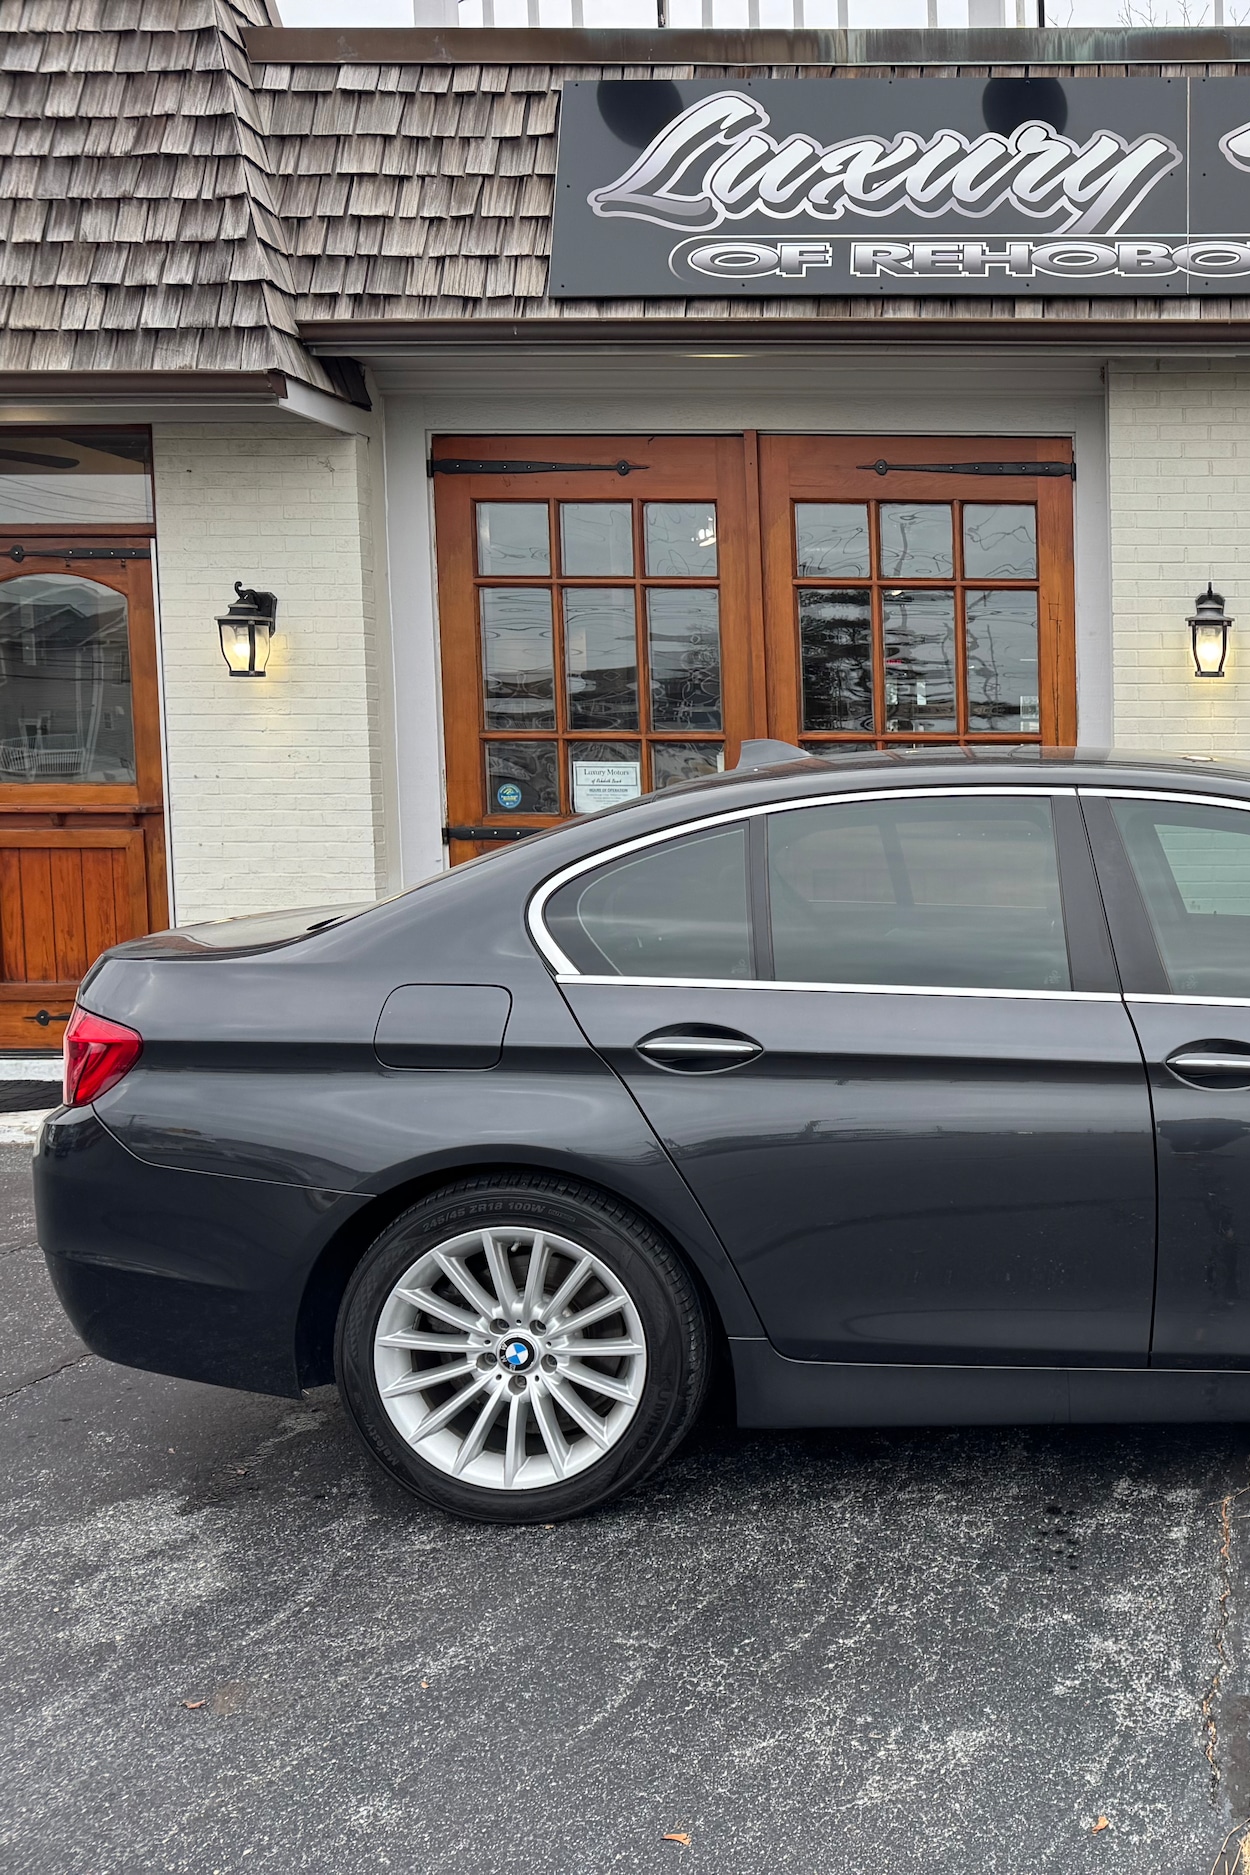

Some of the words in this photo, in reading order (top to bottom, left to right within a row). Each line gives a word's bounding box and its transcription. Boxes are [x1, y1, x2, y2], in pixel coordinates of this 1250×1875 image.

[588, 90, 1183, 236] Luxury
[688, 241, 832, 277] OF
[421, 1207, 466, 1233] 245/45
[468, 1201, 503, 1215] ZR18
[508, 1201, 546, 1214] 100W
